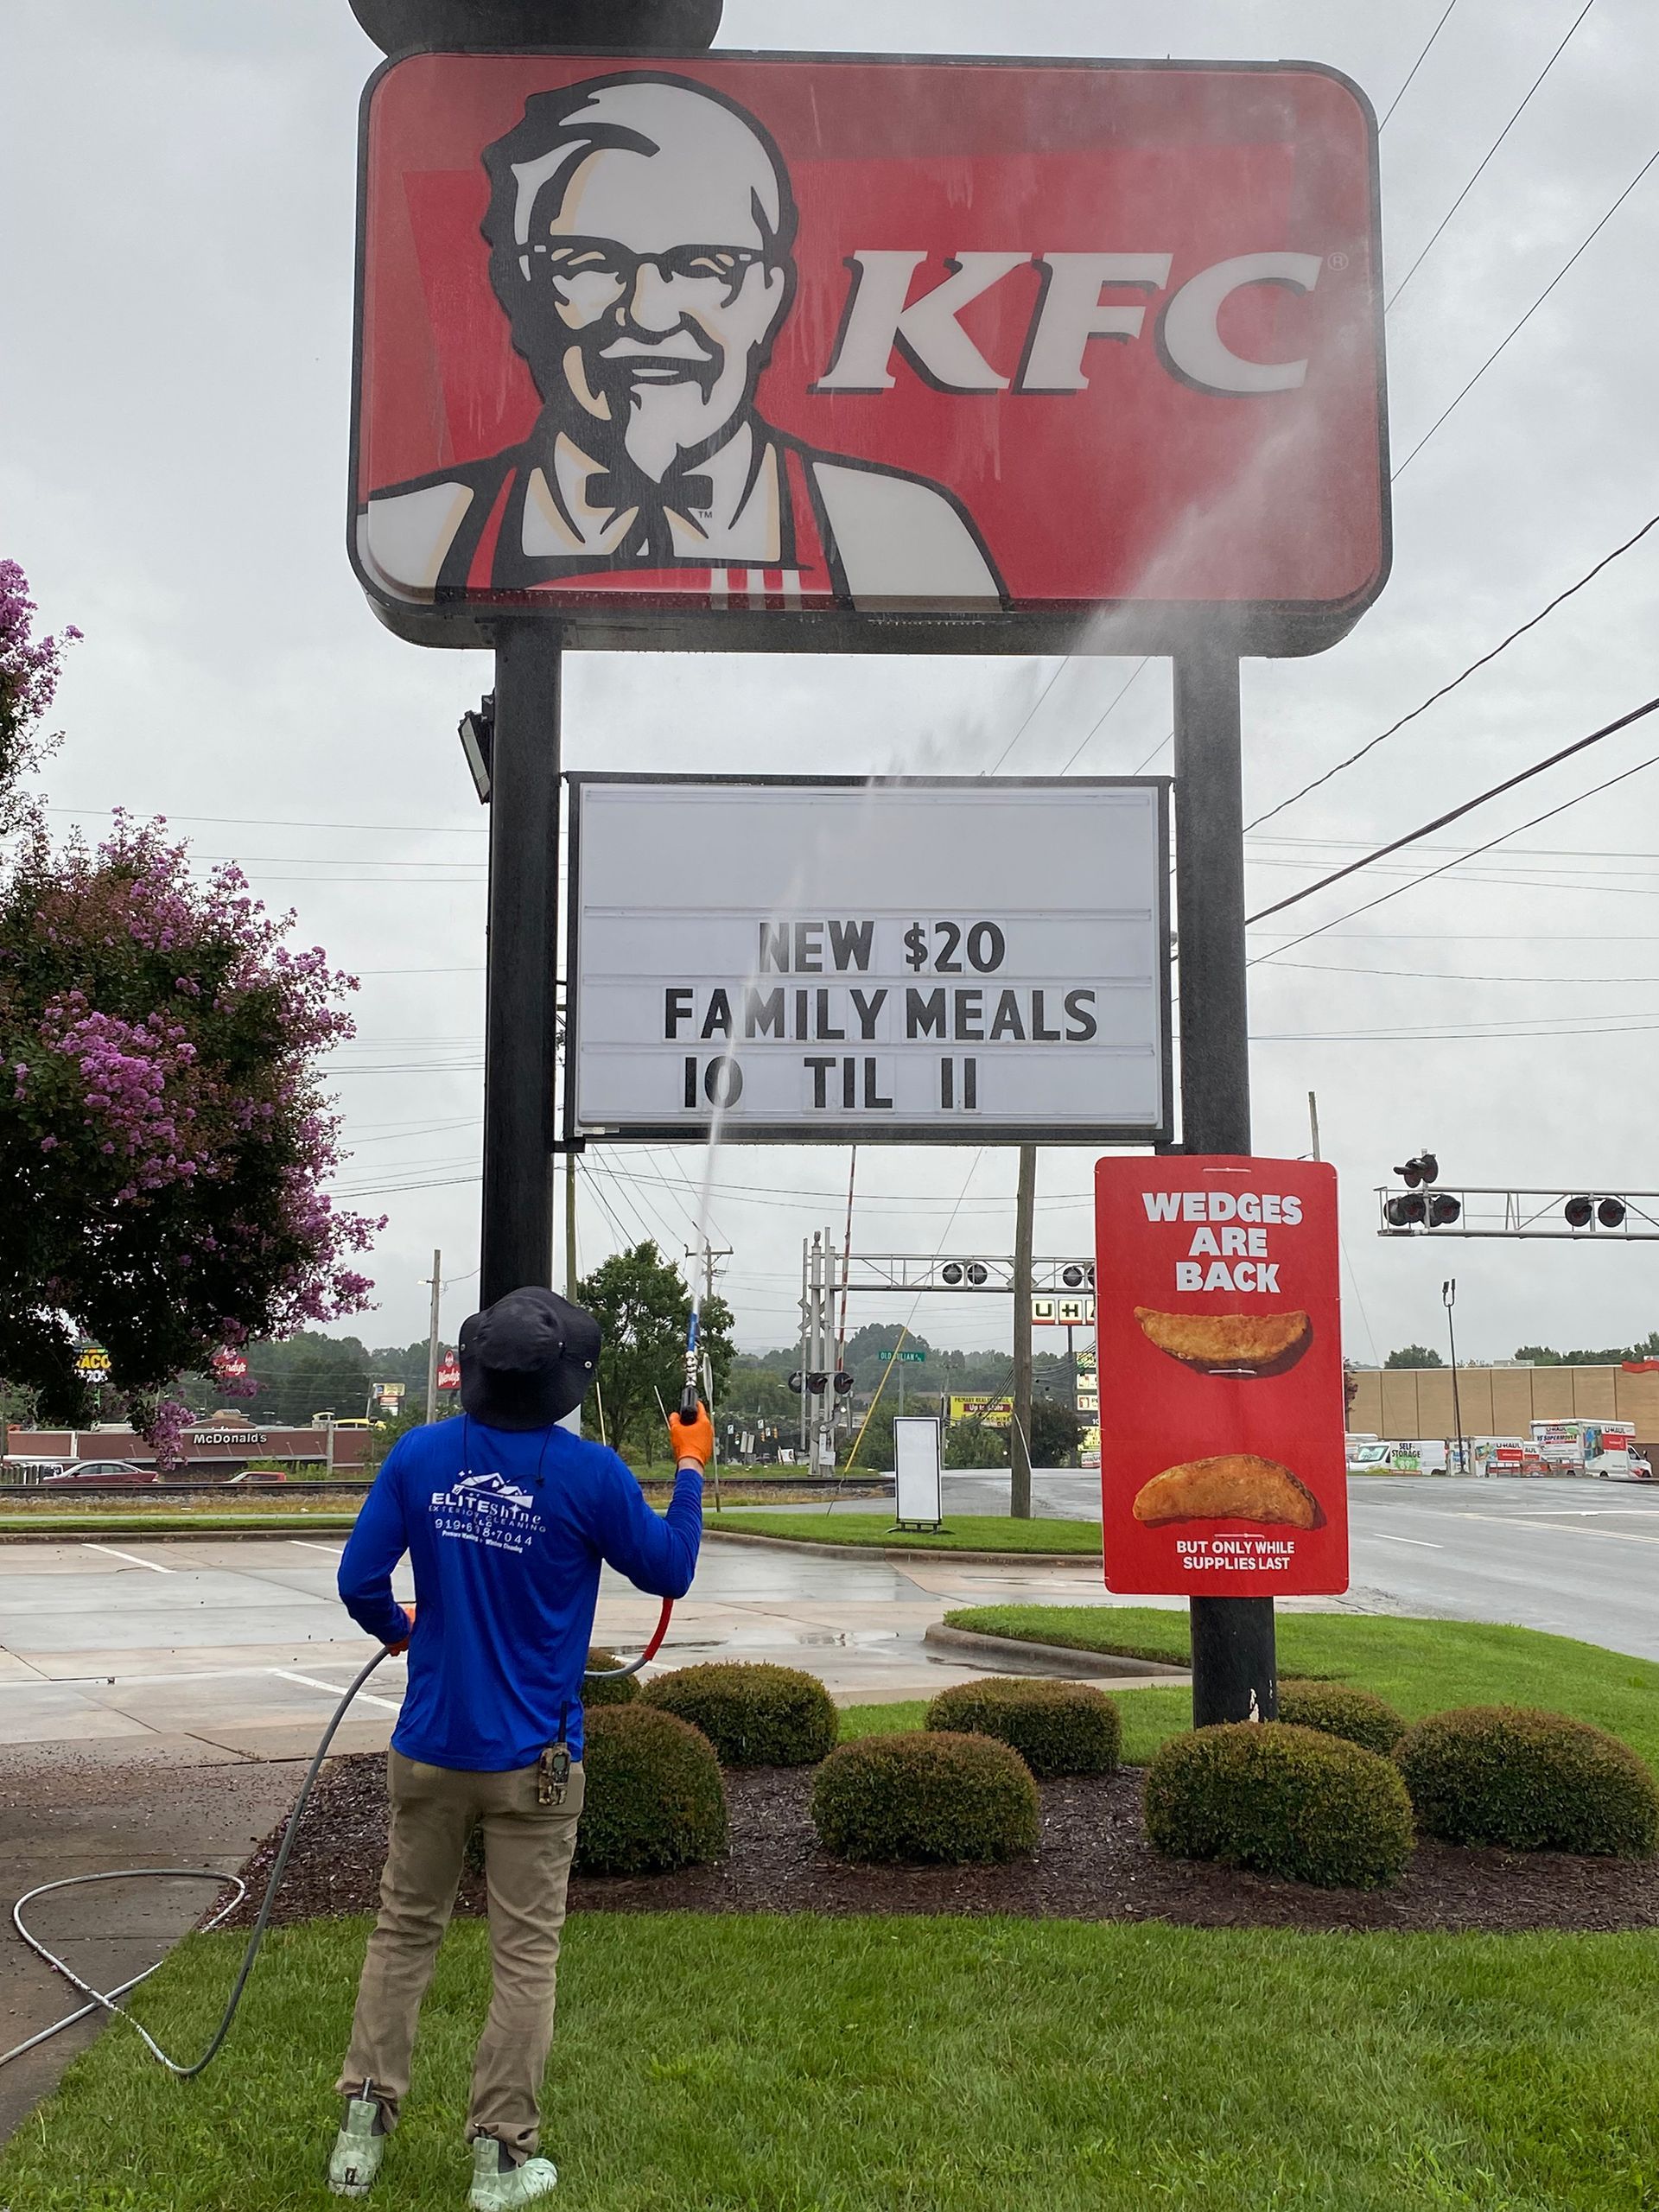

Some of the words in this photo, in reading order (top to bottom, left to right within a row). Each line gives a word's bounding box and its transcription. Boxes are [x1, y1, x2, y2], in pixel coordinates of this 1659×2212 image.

[806, 250, 1324, 397] KFC
[759, 920, 874, 973] NEW
[903, 921, 1006, 974] $20
[664, 988, 888, 1040] FAMILY
[906, 988, 1097, 1042] MEALS
[804, 1057, 893, 1109] TIL
[1141, 1192, 1303, 1225] WEDGES
[1188, 1226, 1268, 1257] ARE
[1175, 1261, 1281, 1293] BACK
[880, 1351, 892, 1360] OLD
[893, 1352, 914, 1361] ULIAN
[193, 1433, 267, 1444] McDonald's
[1176, 1541, 1208, 1554] BUT
[1211, 1541, 1253, 1554] ONLY
[1255, 1541, 1295, 1554] WHILE
[1183, 1556, 1256, 1570] SUPPLIES
[1258, 1557, 1290, 1570] LAST
